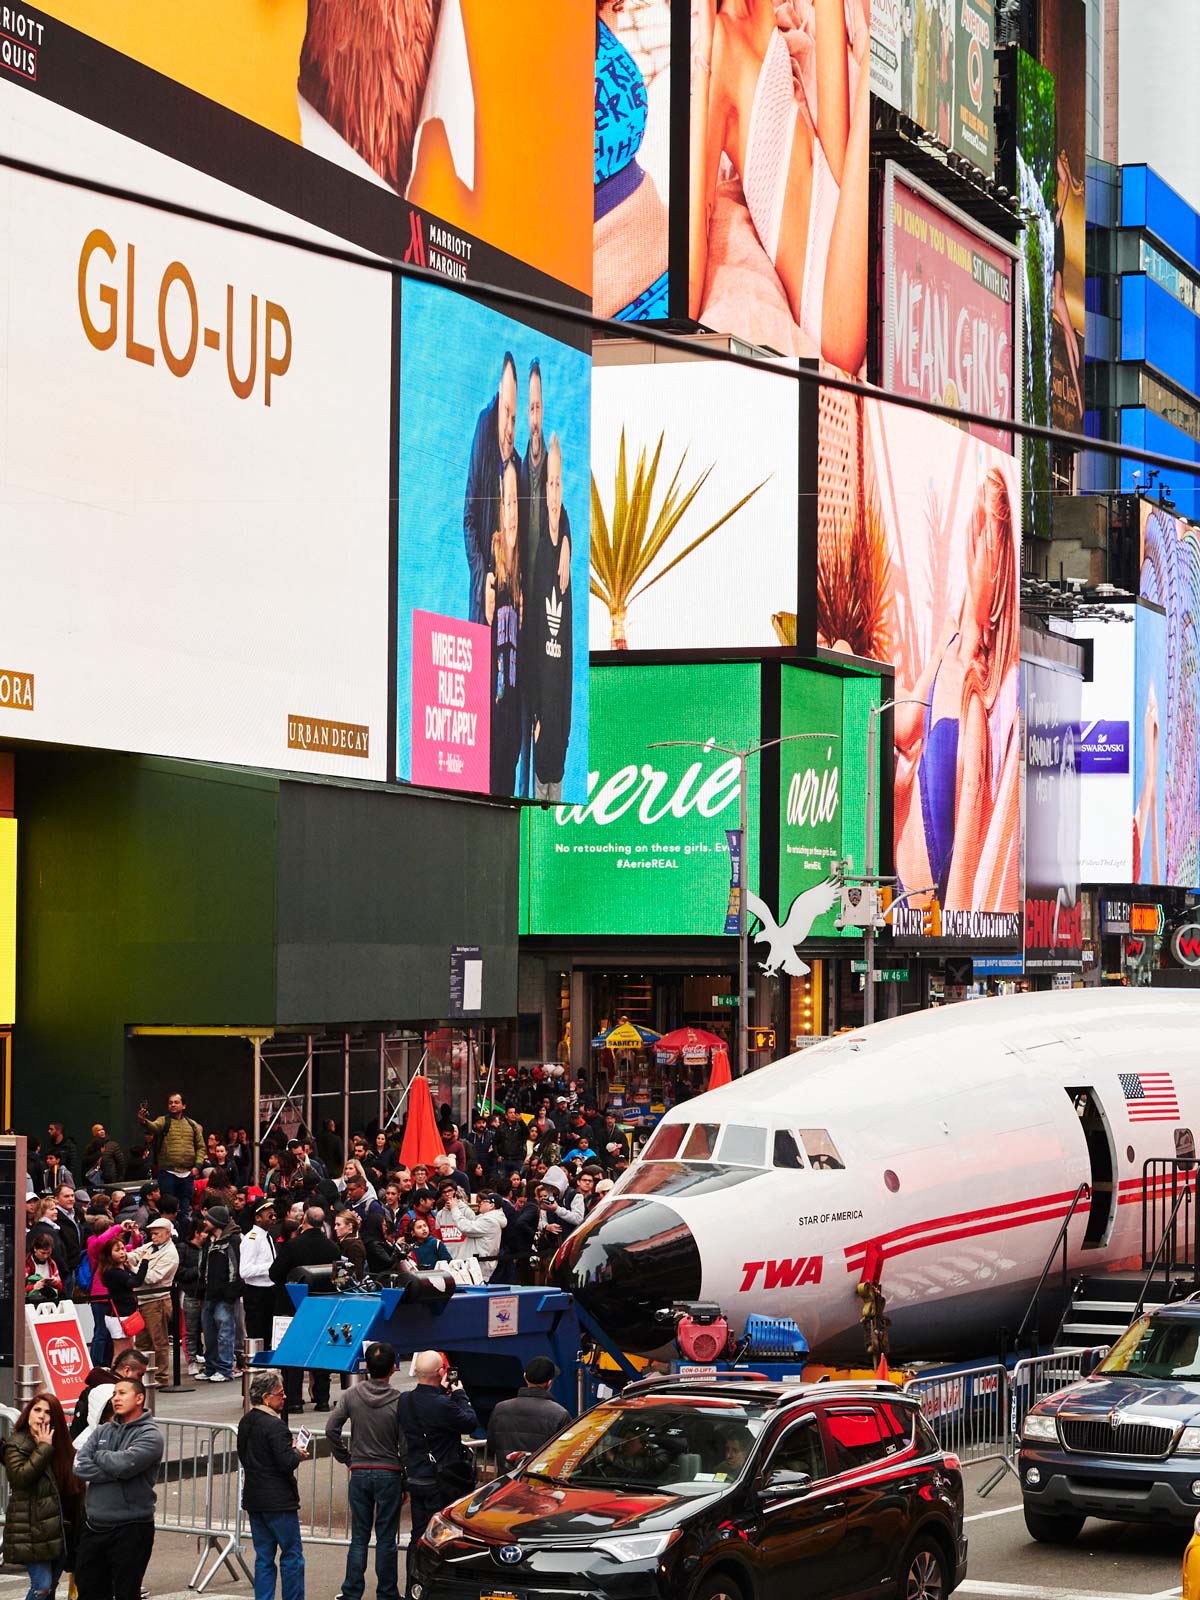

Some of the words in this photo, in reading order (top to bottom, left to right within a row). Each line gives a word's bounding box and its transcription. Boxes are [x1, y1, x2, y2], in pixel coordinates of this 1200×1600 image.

[0, 6, 44, 46] RIOTT
[2, 40, 35, 75] QUIS
[429, 224, 472, 260] MARRIOTT
[904, 208, 927, 244] KNOW
[929, 223, 945, 256] YOU
[946, 238, 972, 274] WANNA
[429, 250, 468, 282] MARQUIS
[973, 255, 982, 281] SIT
[983, 262, 1000, 293] WITH
[1000, 274, 1009, 301] US
[77, 228, 293, 408] GLO-UP
[893, 267, 949, 398] MEAN
[955, 306, 1010, 421] GIRLS
[431, 630, 472, 673] WIRELESS
[545, 638, 562, 658] adidas
[0, 674, 33, 706] ORA
[438, 669, 466, 709] RULES
[289, 721, 329, 749] URBAN
[331, 728, 369, 752] DECAY
[451, 711, 478, 747] APPLY
[1081, 743, 1124, 752] SWAROVSKI
[555, 737, 742, 826] aerie
[786, 745, 839, 828] aerie
[555, 843, 571, 854] No
[573, 842, 632, 856] retouching
[634, 844, 649, 854] on
[651, 843, 681, 854] these
[684, 842, 712, 856] girls.
[616, 858, 679, 869] #AerieREAL
[946, 910, 972, 937] EAGLE
[972, 911, 1019, 938] OUTFITTERS
[1025, 899, 1083, 949] CHICAGO
[1107, 901, 1121, 921] BLUE
[882, 971, 889, 981] W
[891, 971, 901, 981] 46
[768, 1034, 775, 1047] 2
[798, 1215, 819, 1226] STAR
[820, 1213, 830, 1223] OF
[831, 1209, 864, 1222] AMERICA
[739, 1255, 824, 1292] TWA
[48, 1346, 81, 1366] TWA
[61, 1376, 83, 1385] HOTEL
